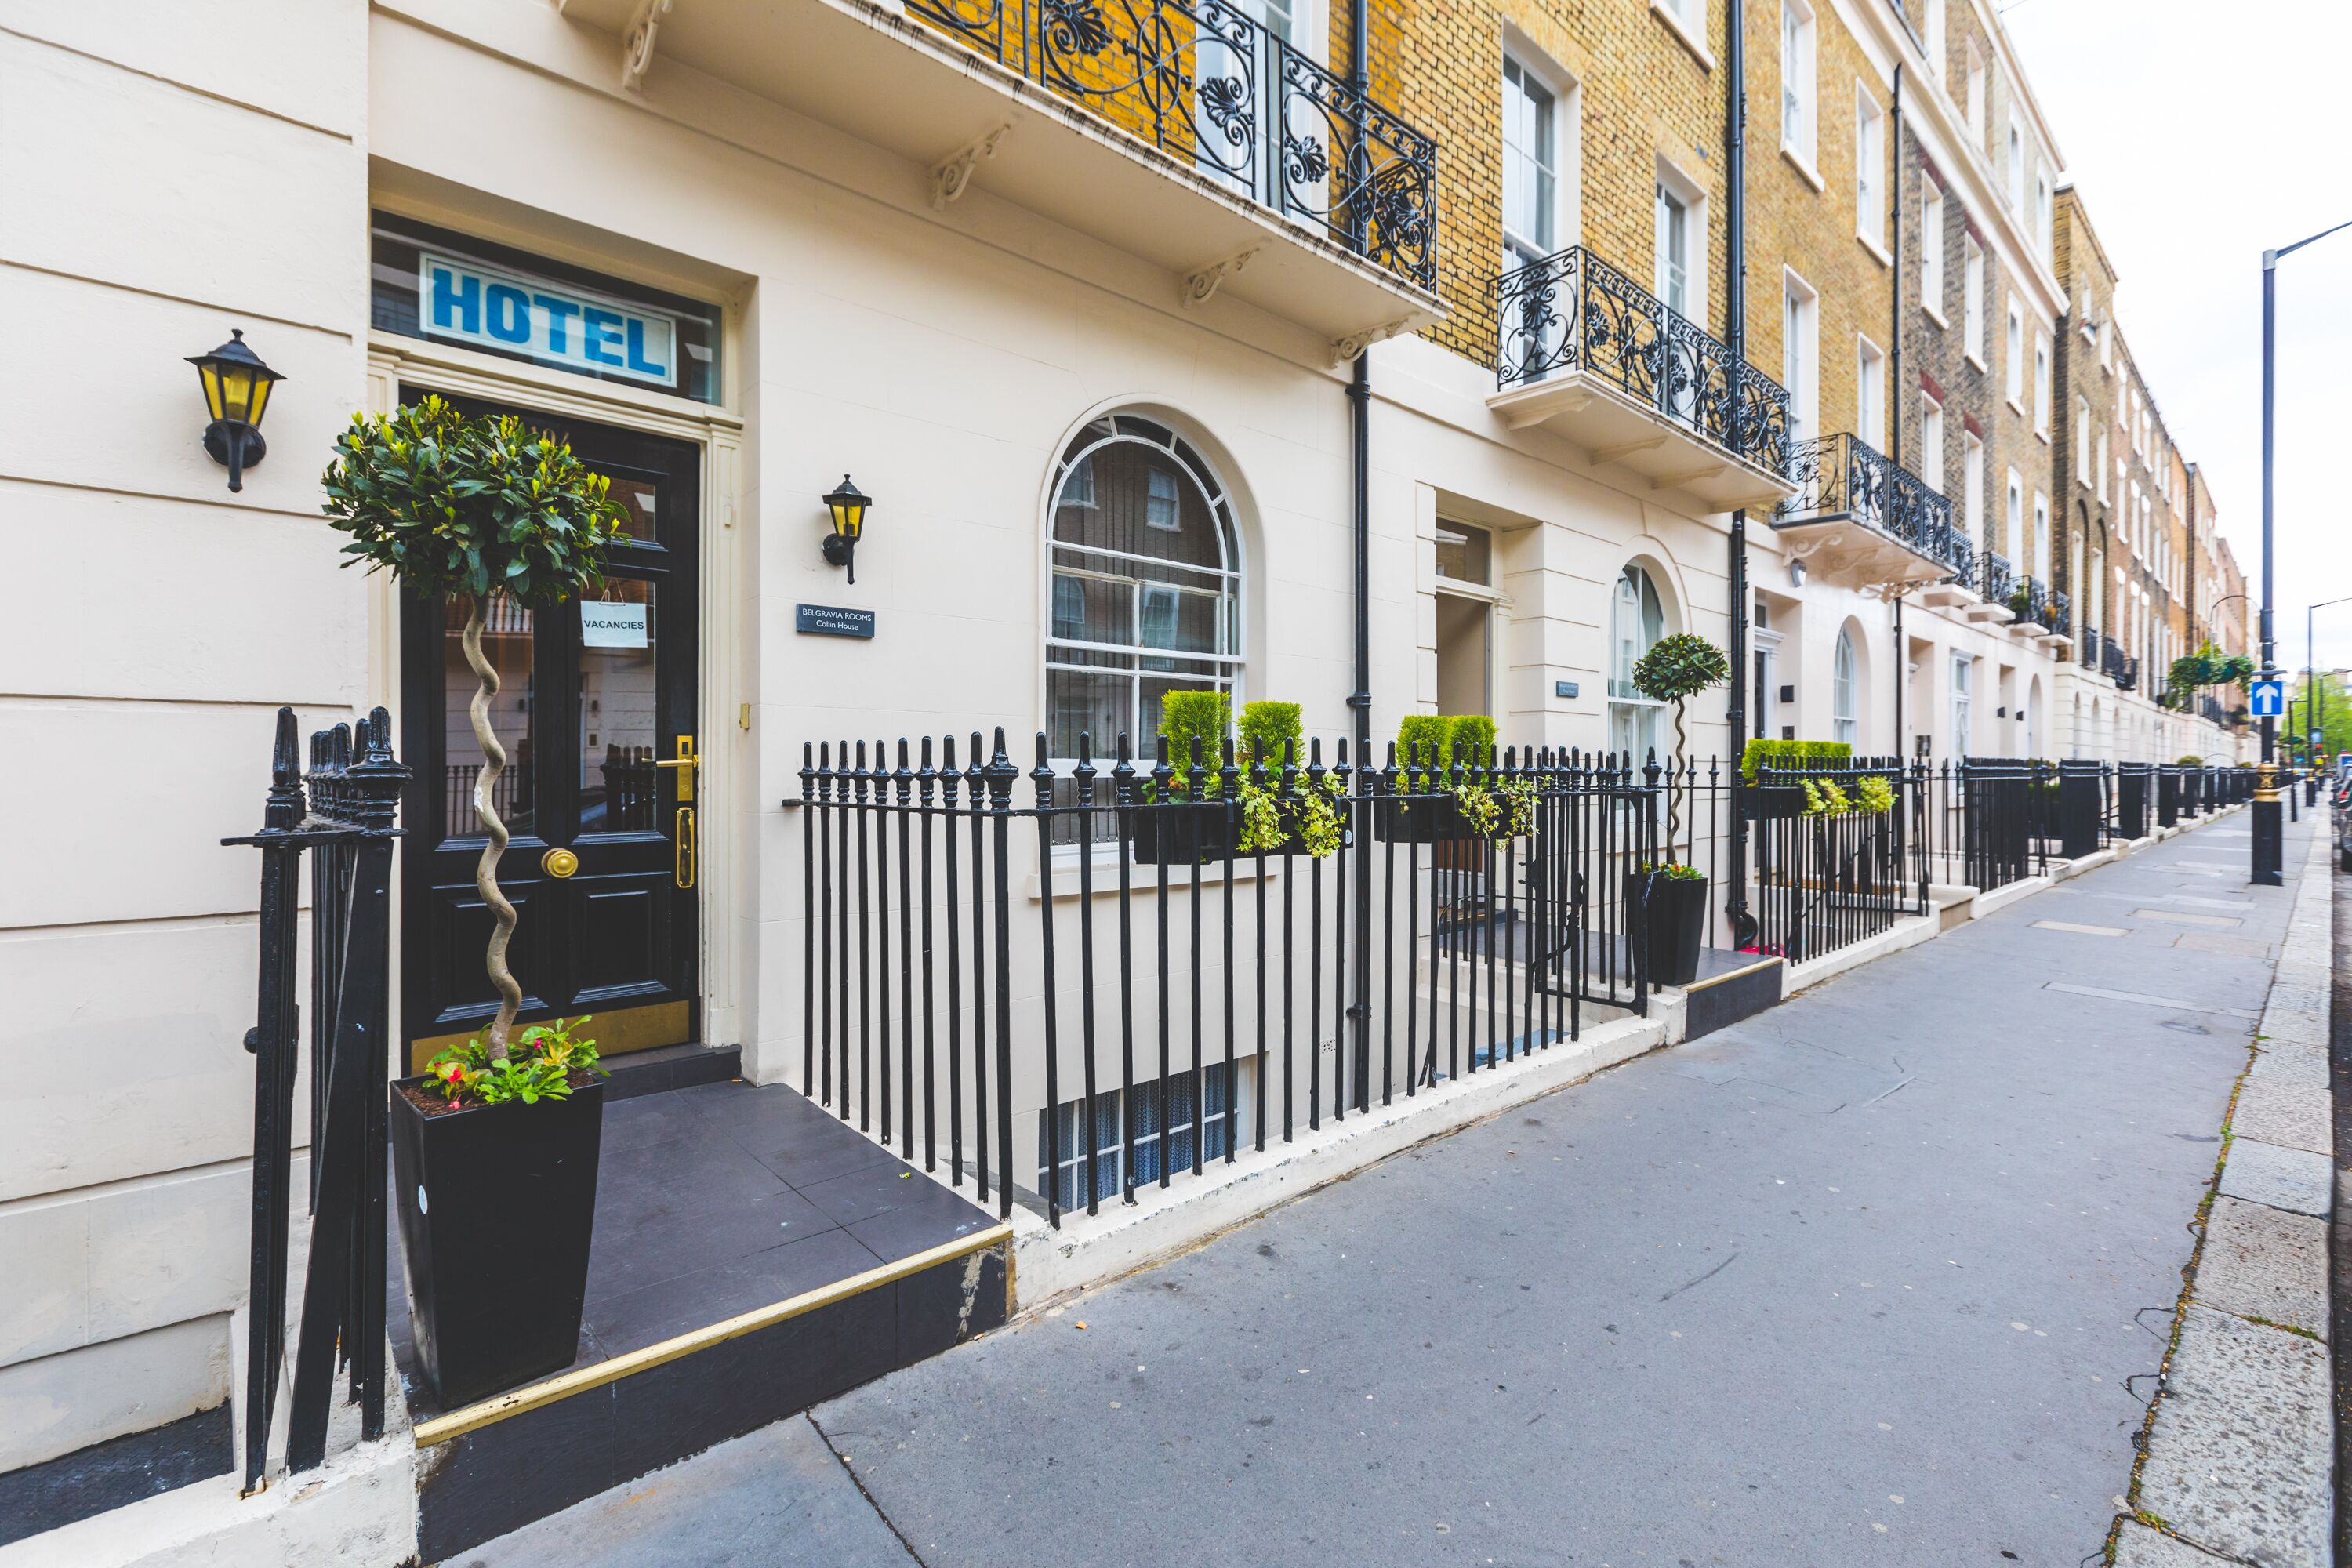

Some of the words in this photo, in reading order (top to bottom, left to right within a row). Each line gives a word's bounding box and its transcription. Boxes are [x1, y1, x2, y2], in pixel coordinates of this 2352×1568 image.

[433, 267, 666, 377] HOTEL
[802, 608, 843, 619] BELGRAVIA
[845, 613, 872, 622] ROOMS
[583, 620, 644, 630] VACANCIES
[837, 622, 858, 630] House
